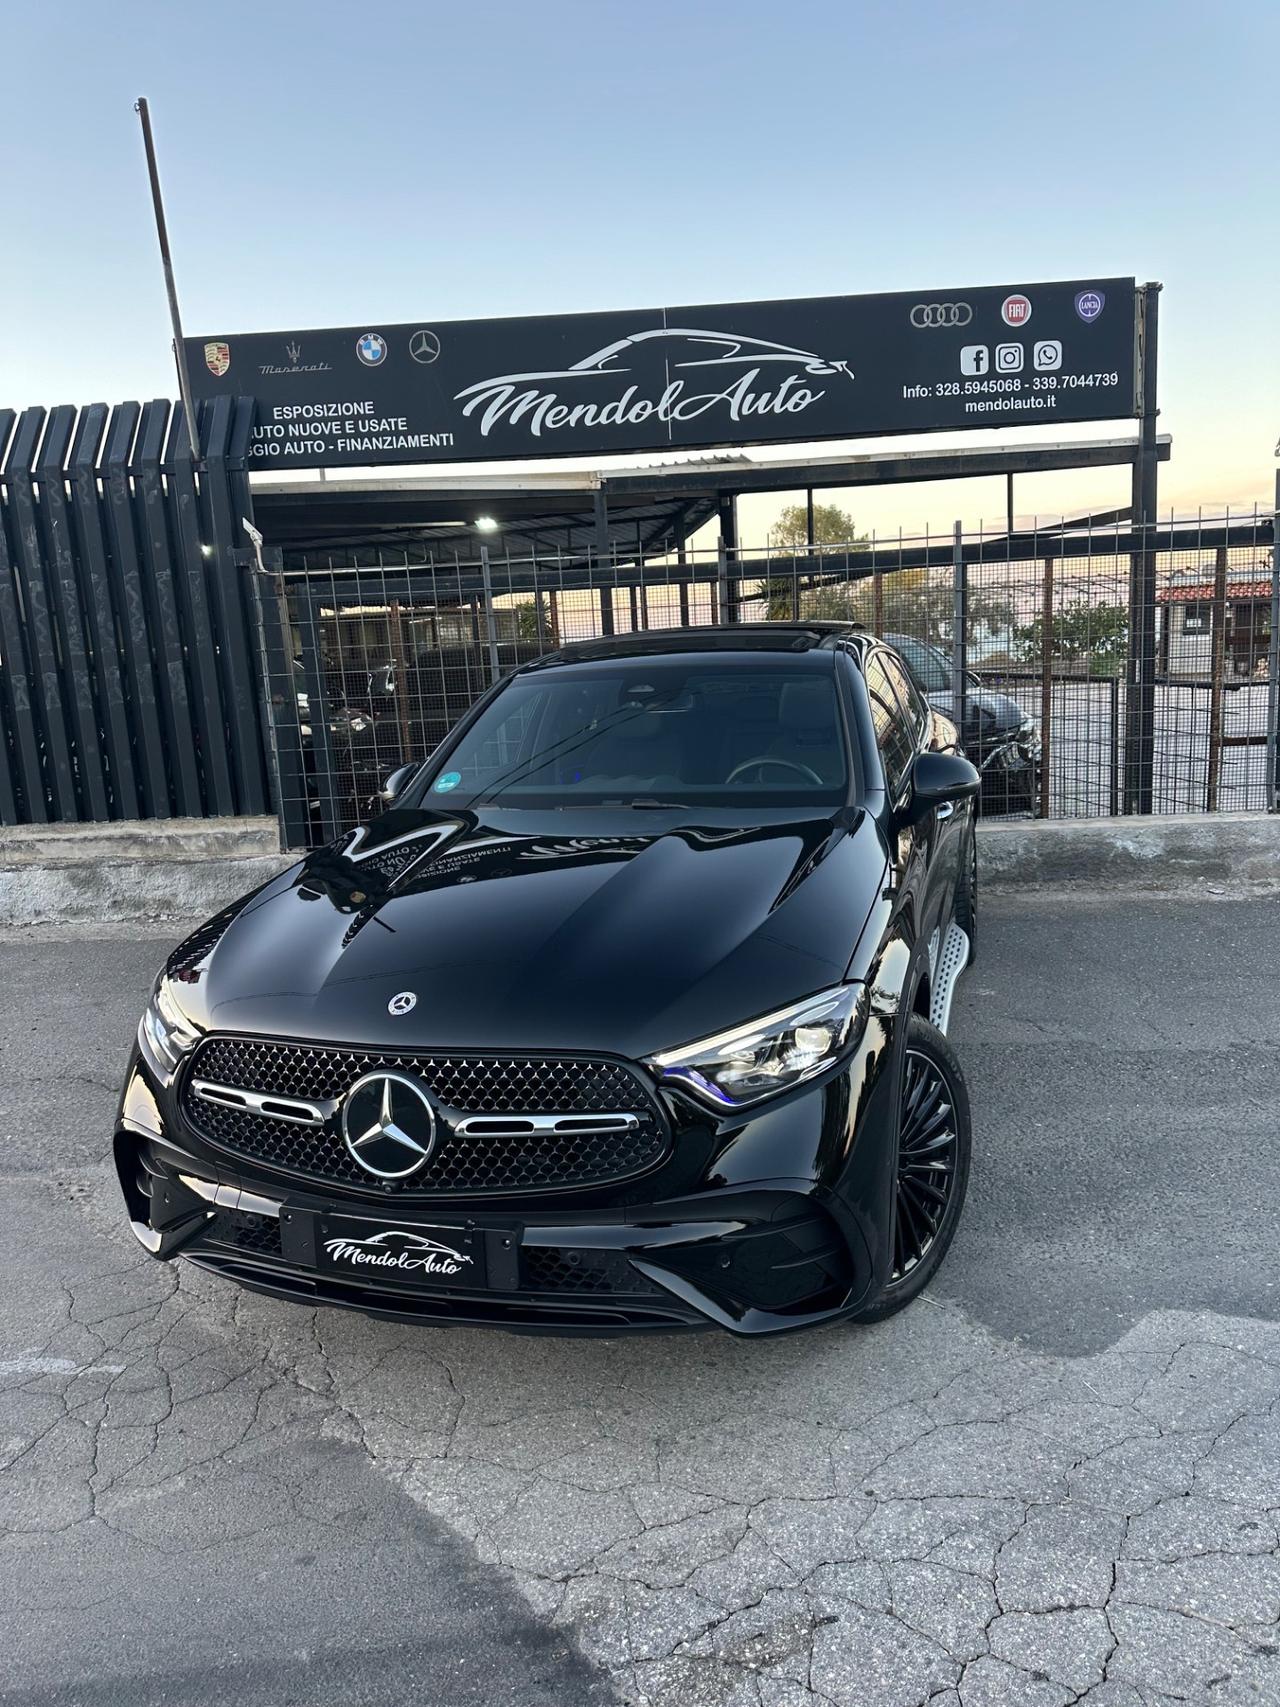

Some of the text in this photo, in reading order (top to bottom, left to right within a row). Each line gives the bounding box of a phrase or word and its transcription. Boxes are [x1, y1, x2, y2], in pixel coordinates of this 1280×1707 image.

[1008, 303, 1025, 318] FIAT
[259, 362, 332, 374] Maserati
[903, 385, 932, 398] Info:
[936, 379, 1021, 396] 328.5945068
[1033, 373, 1118, 390] 339.7044739
[273, 401, 375, 420] ESPOSIZIONE
[965, 395, 1056, 412] mendolauto.it
[252, 417, 408, 439] UTO NUOVE E USATE
[284, 440, 325, 455] AUTO
[338, 433, 454, 452] FINANZIAMENTI
